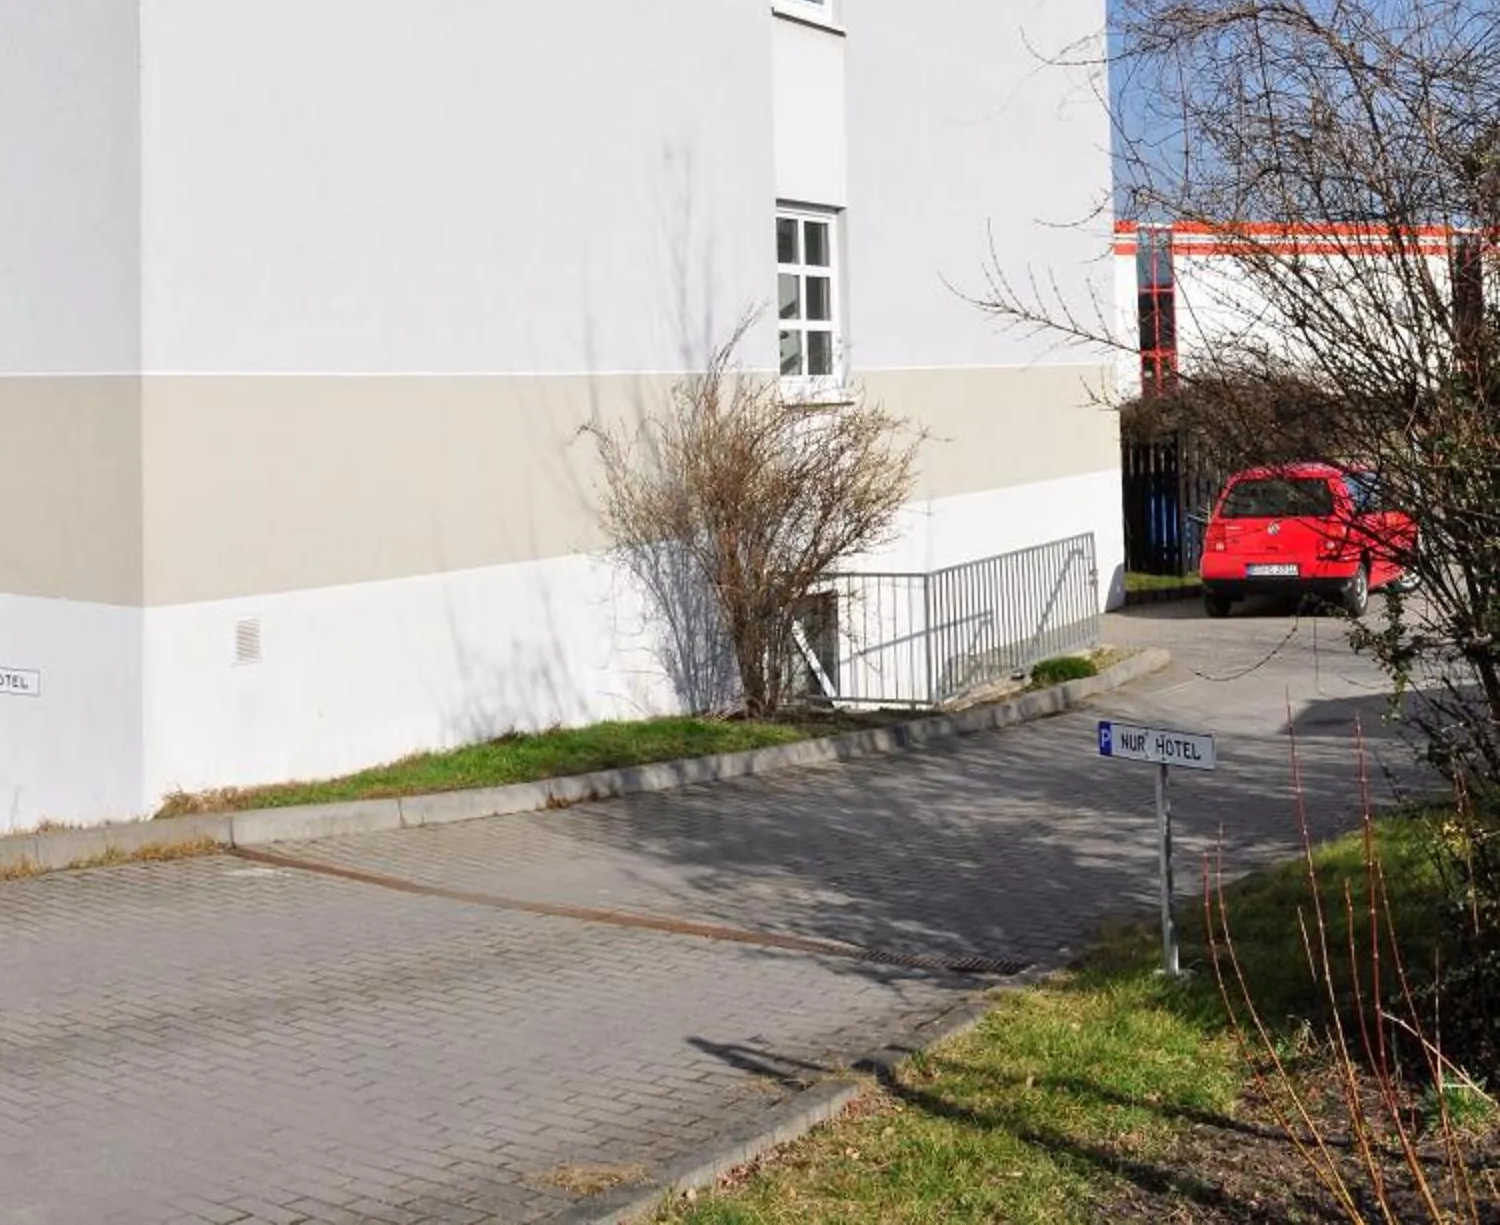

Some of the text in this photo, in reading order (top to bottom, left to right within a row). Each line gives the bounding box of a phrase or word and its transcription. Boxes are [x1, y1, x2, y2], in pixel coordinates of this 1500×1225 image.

[1101, 729, 1201, 760] P NUR HOTEL
